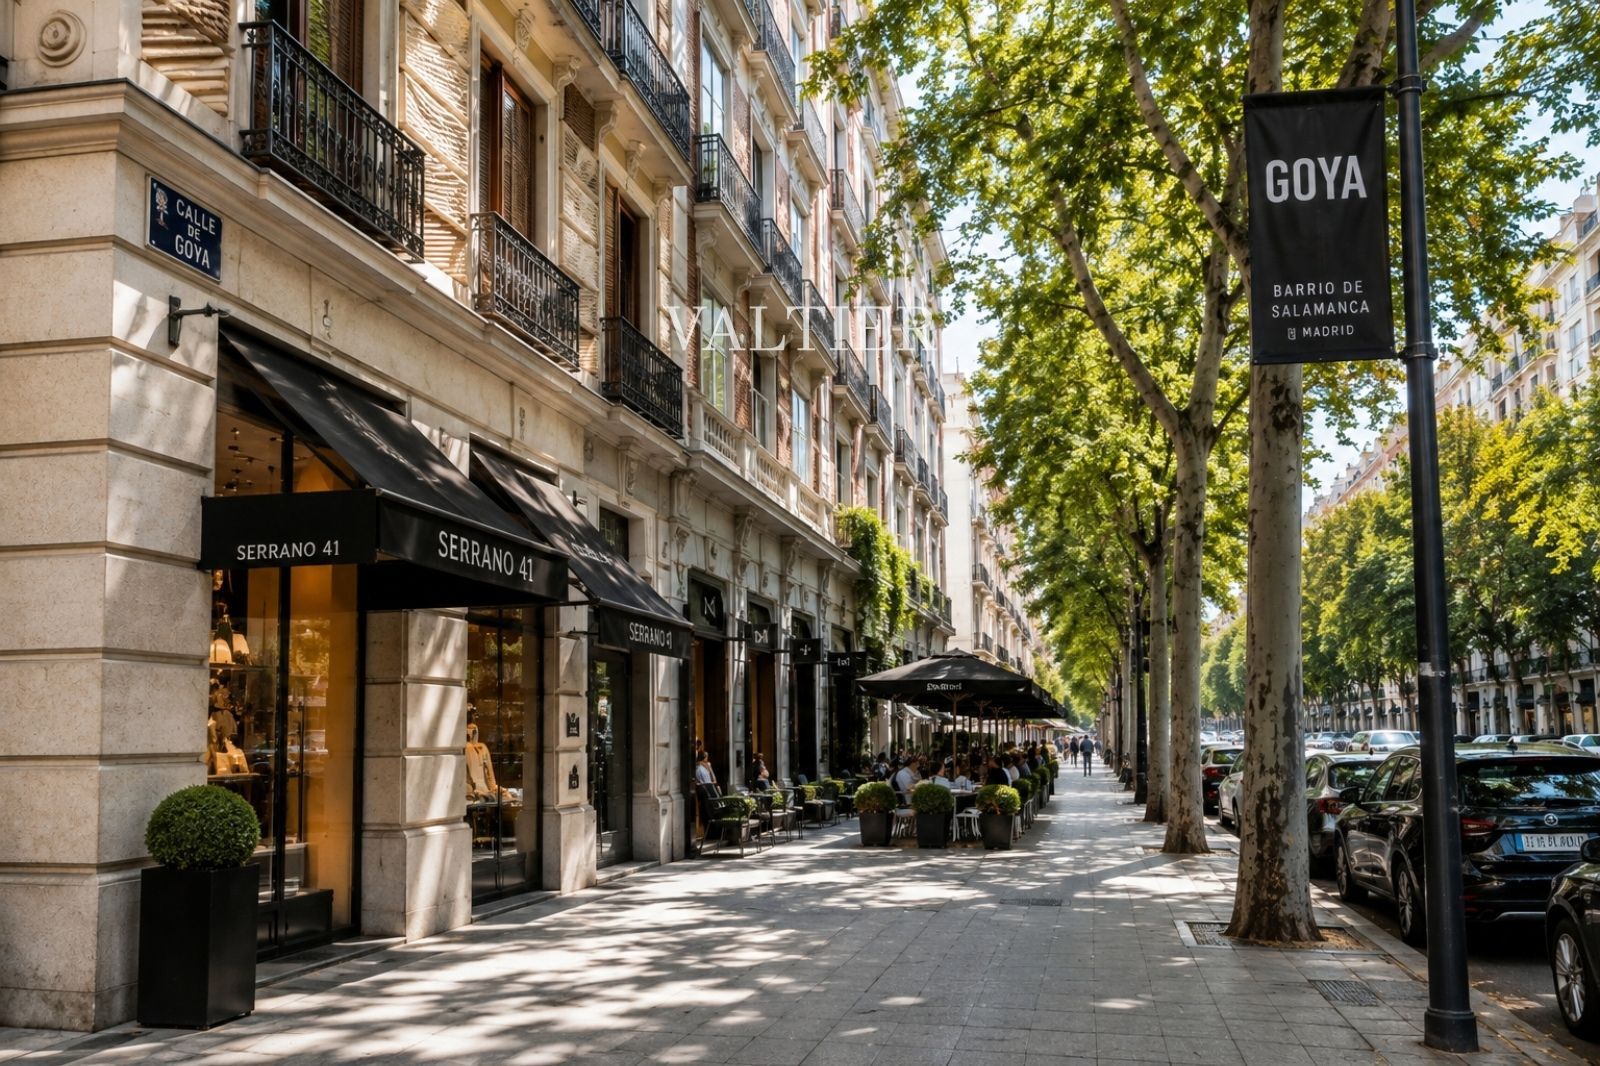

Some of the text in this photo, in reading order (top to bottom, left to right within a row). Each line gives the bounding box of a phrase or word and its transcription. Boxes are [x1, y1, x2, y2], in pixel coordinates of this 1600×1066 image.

[1265, 155, 1368, 203] GOYA
[176, 199, 216, 235] CALLE
[187, 224, 201, 242] DE
[175, 234, 210, 269] GOYA
[1273, 280, 1363, 297] BARRIO DE
[1271, 300, 1370, 318] SALAMANCA
[1302, 325, 1355, 338] MADRID
[236, 540, 340, 561] SERRANO 41
[438, 530, 534, 583] SERRANO 41
[629, 621, 666, 647] SERRANO
